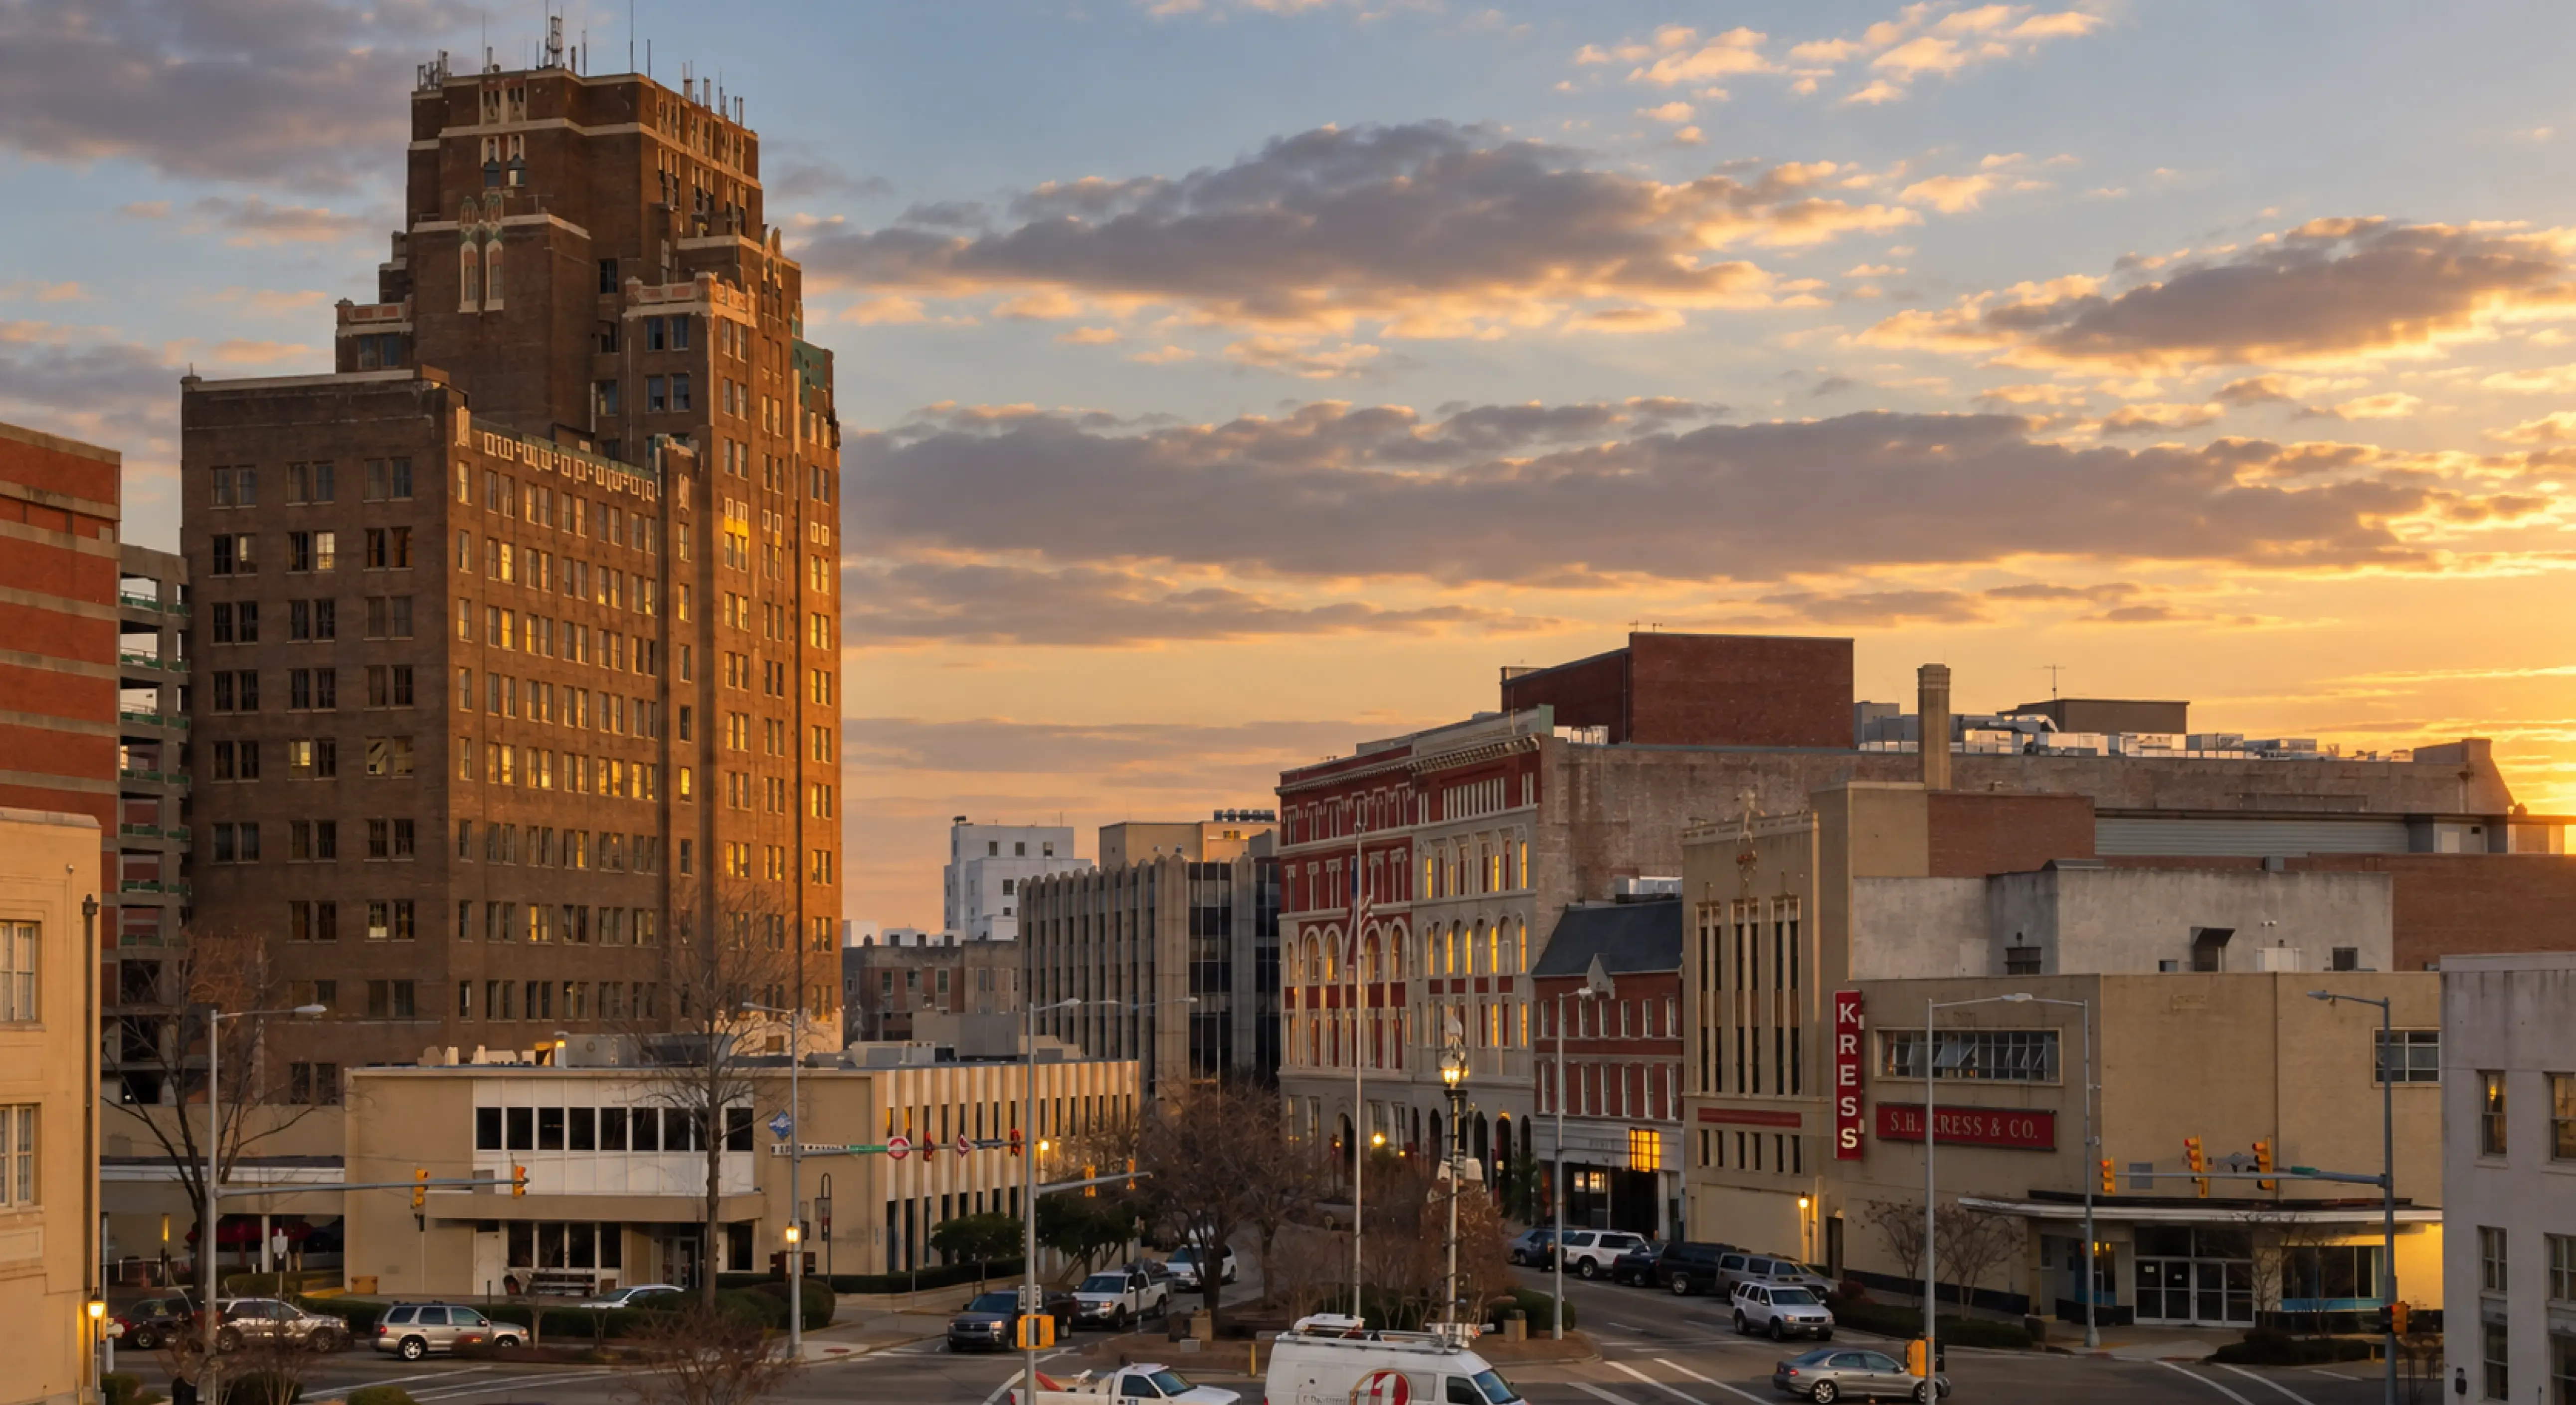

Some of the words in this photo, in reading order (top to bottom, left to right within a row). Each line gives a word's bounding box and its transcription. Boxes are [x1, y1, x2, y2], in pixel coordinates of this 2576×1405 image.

[1839, 1003, 1857, 1149] KRESS
[1990, 1117, 2001, 1137] &
[2009, 1119, 2038, 1139] CO.
